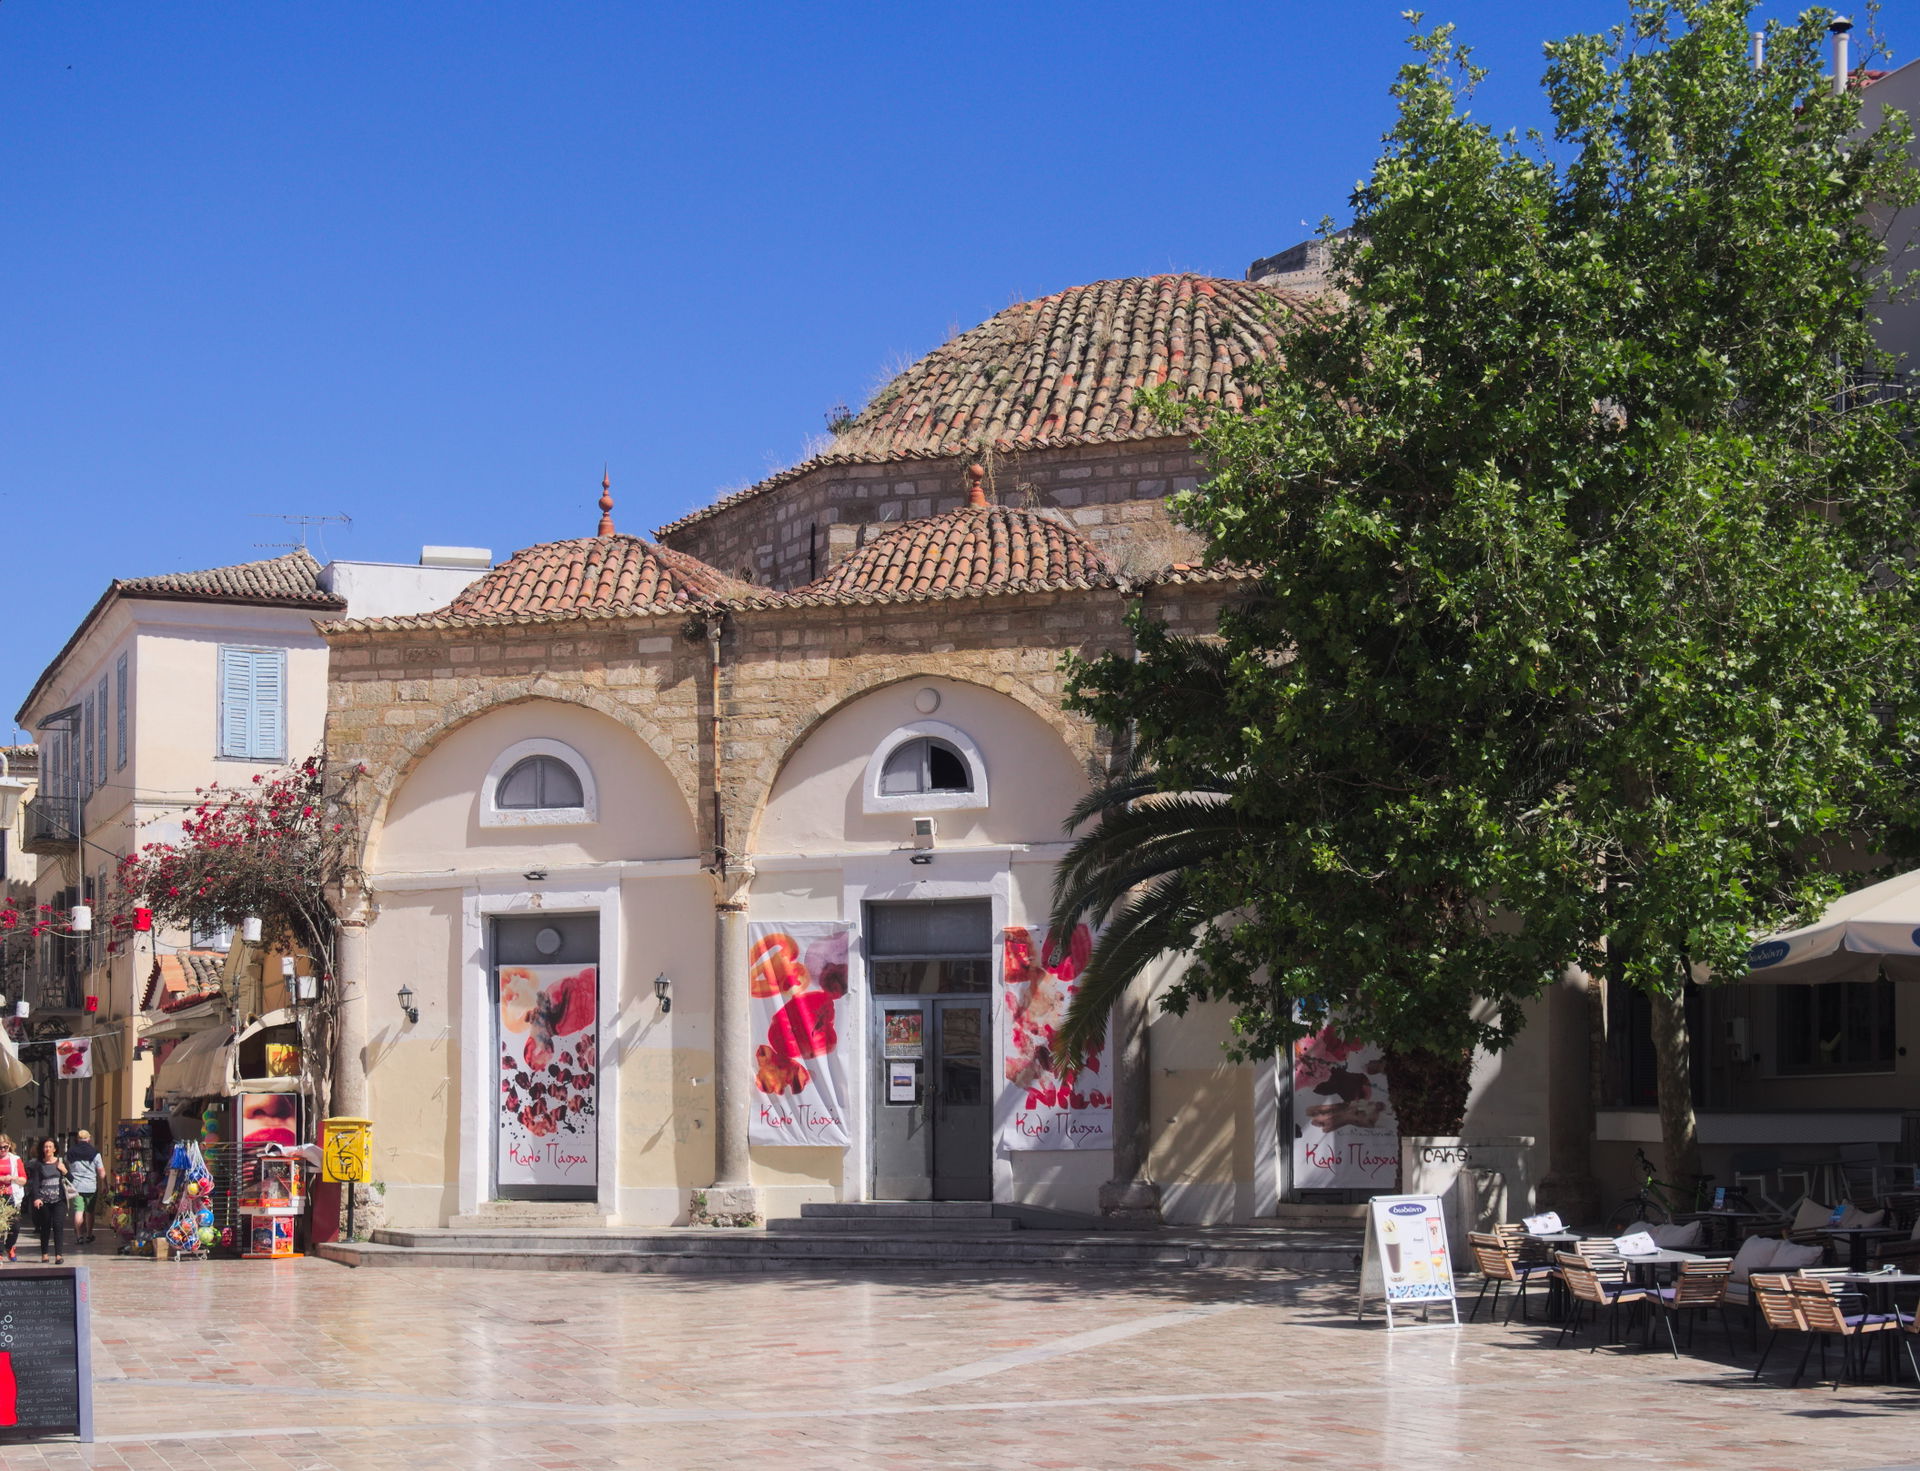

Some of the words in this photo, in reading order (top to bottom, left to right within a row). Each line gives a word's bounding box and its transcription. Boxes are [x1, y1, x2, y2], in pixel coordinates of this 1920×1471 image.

[760, 1104, 793, 1132] Καλό
[798, 1104, 842, 1137] Πάσχα
[1016, 1112, 1050, 1144] Καλό
[1055, 1112, 1103, 1148] Πάσχα
[508, 1142, 541, 1173] Καλό
[546, 1142, 588, 1176] Πάσχα
[1305, 1142, 1343, 1176] Καλό
[1348, 1143, 1399, 1179] Πάσχα
